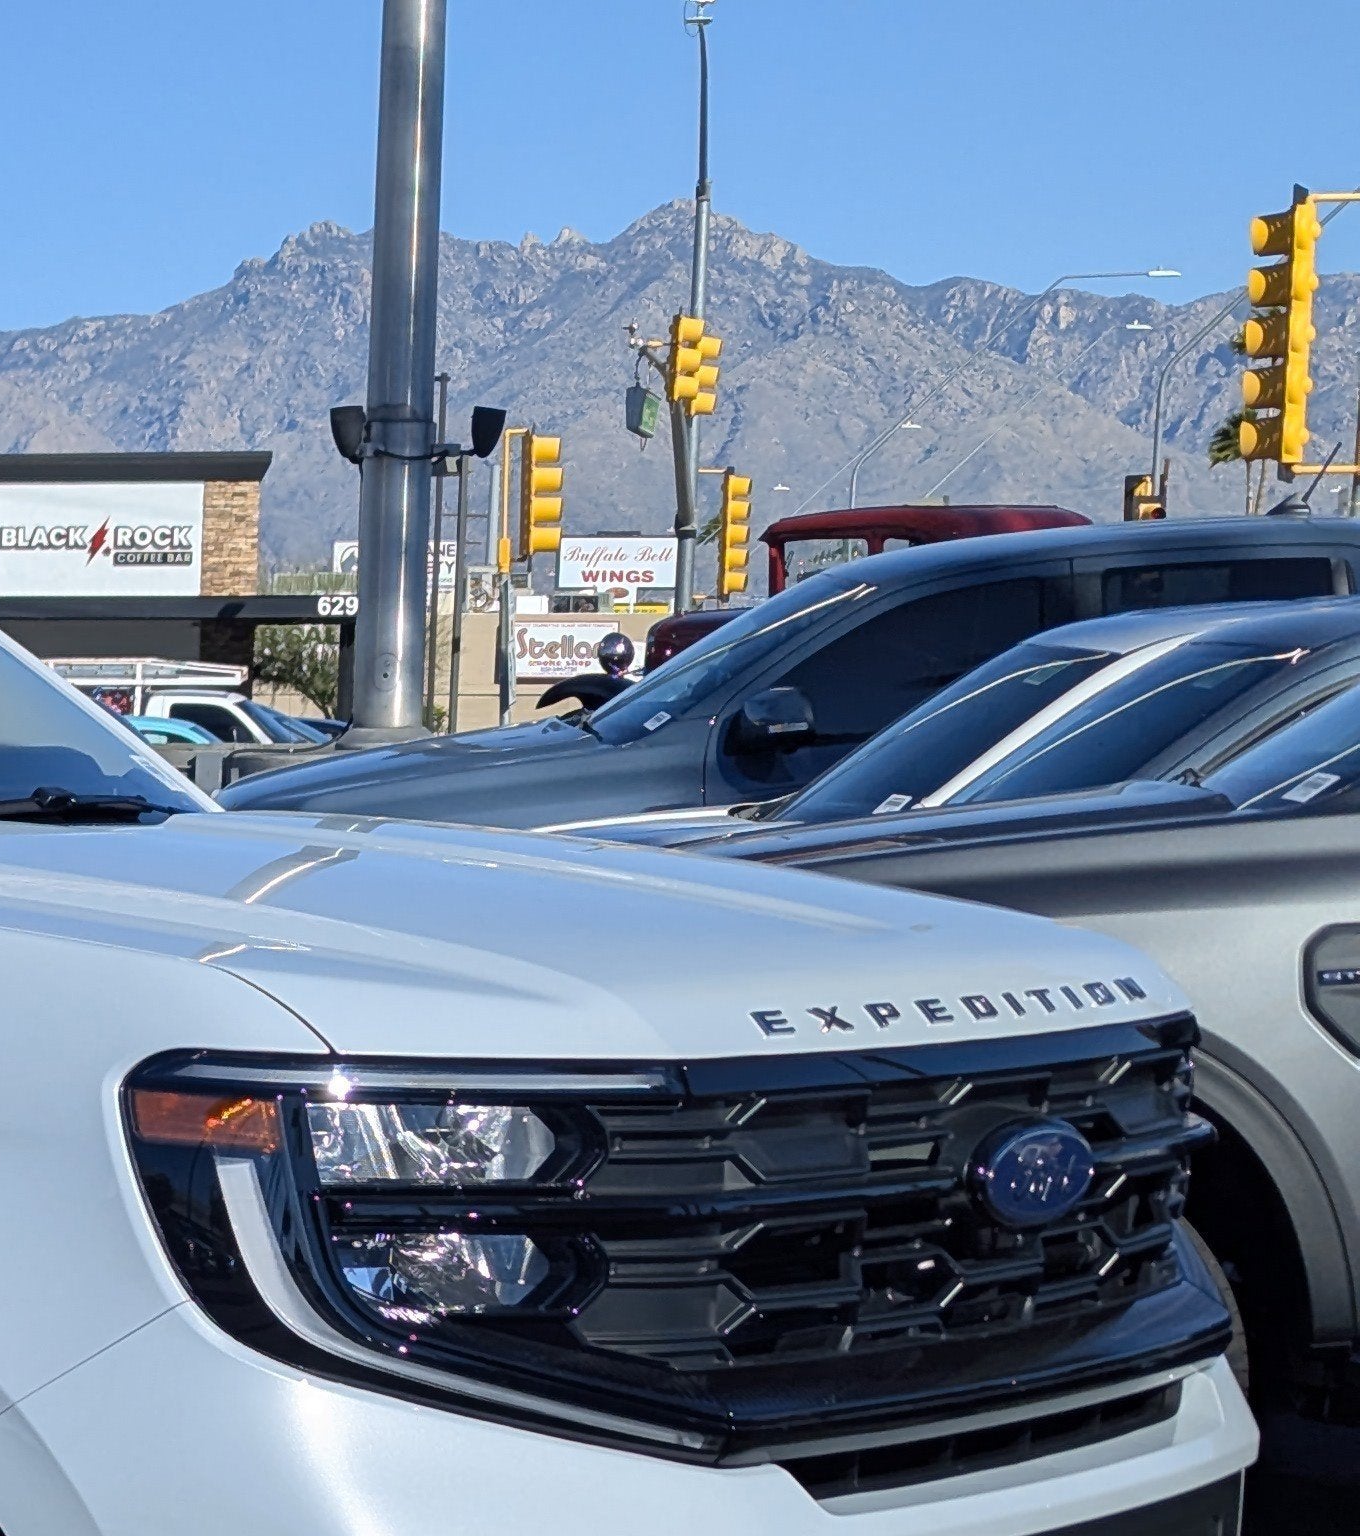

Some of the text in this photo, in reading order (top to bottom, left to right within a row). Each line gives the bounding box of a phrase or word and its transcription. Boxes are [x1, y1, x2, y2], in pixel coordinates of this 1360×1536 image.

[113, 526, 193, 549] ROCK
[116, 553, 191, 563] COFFEE BAR
[564, 546, 673, 567] Buffalo Bell
[581, 570, 654, 583] WINGS
[317, 596, 359, 616] 629
[749, 976, 1148, 1038] EXPEDITION
